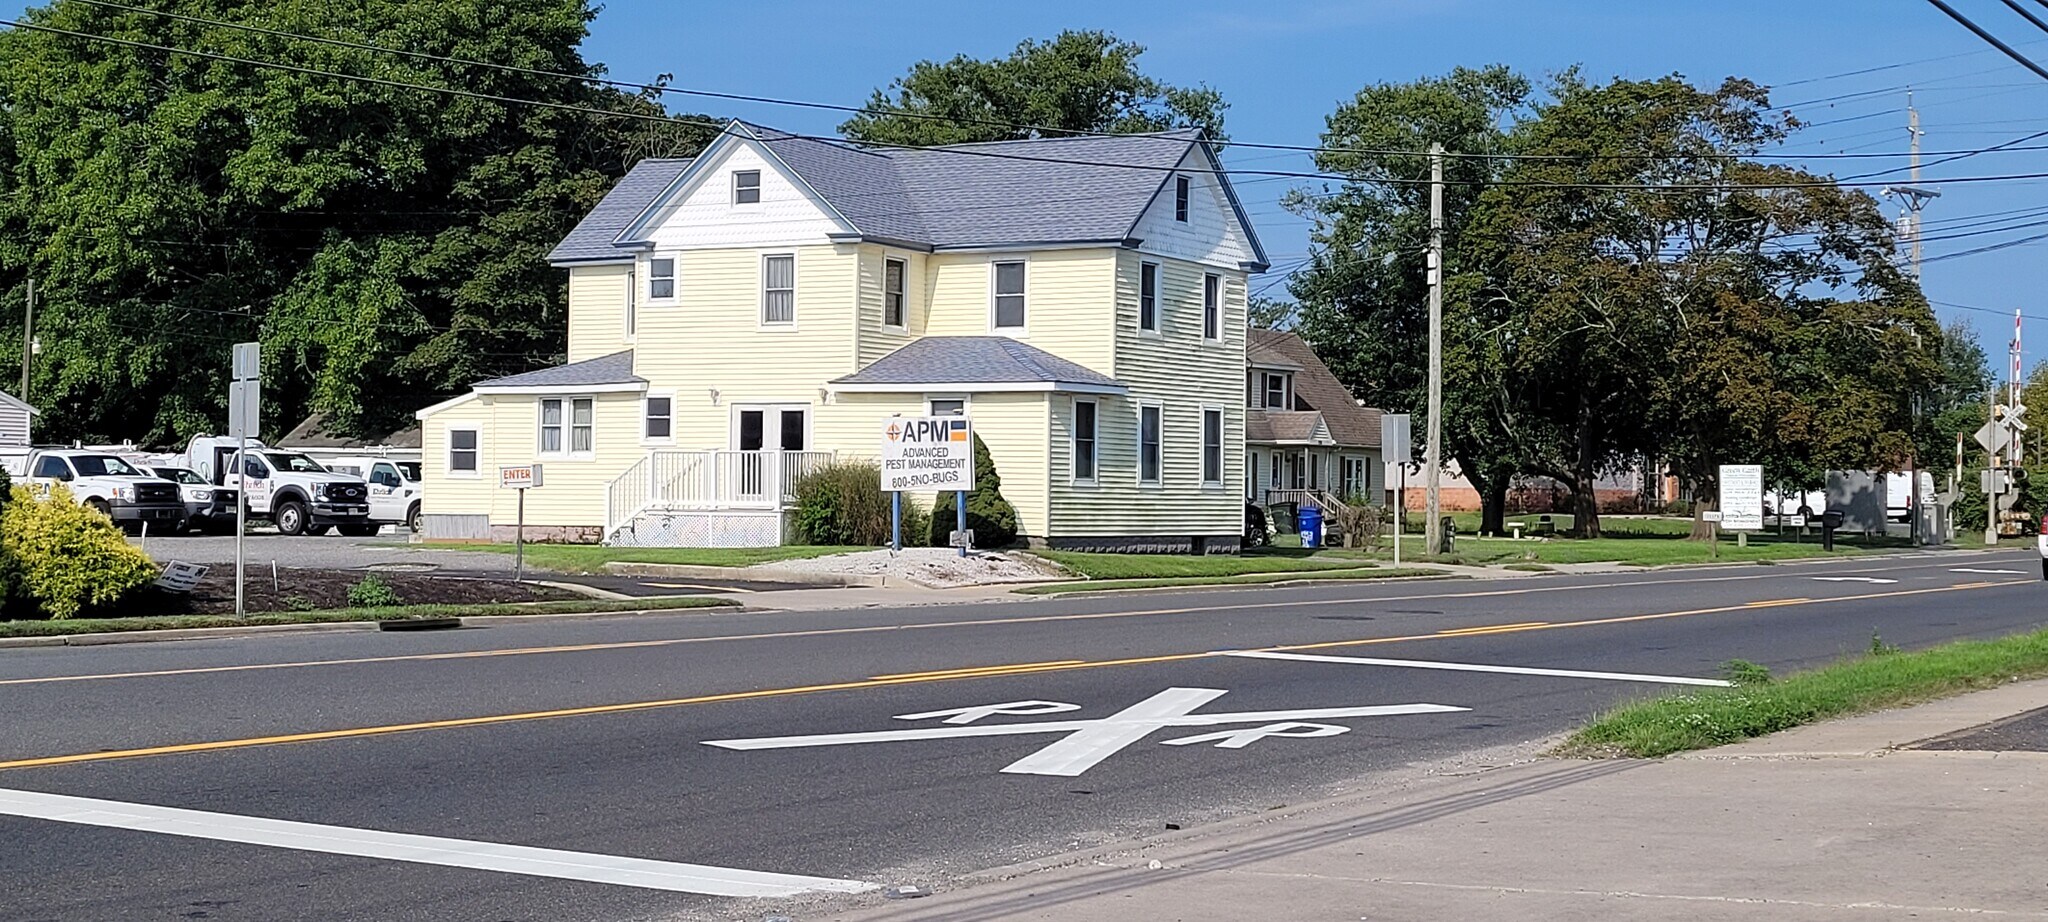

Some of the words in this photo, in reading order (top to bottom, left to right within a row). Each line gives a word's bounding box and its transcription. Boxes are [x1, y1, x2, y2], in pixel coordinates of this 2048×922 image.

[902, 420, 949, 443] APM
[902, 447, 949, 458] ADVANCED
[885, 459, 906, 470] PEST
[908, 458, 966, 469] MANAGEMENT
[503, 469, 531, 480] ENTER
[892, 470, 959, 489] 800-5NO-BUGS
